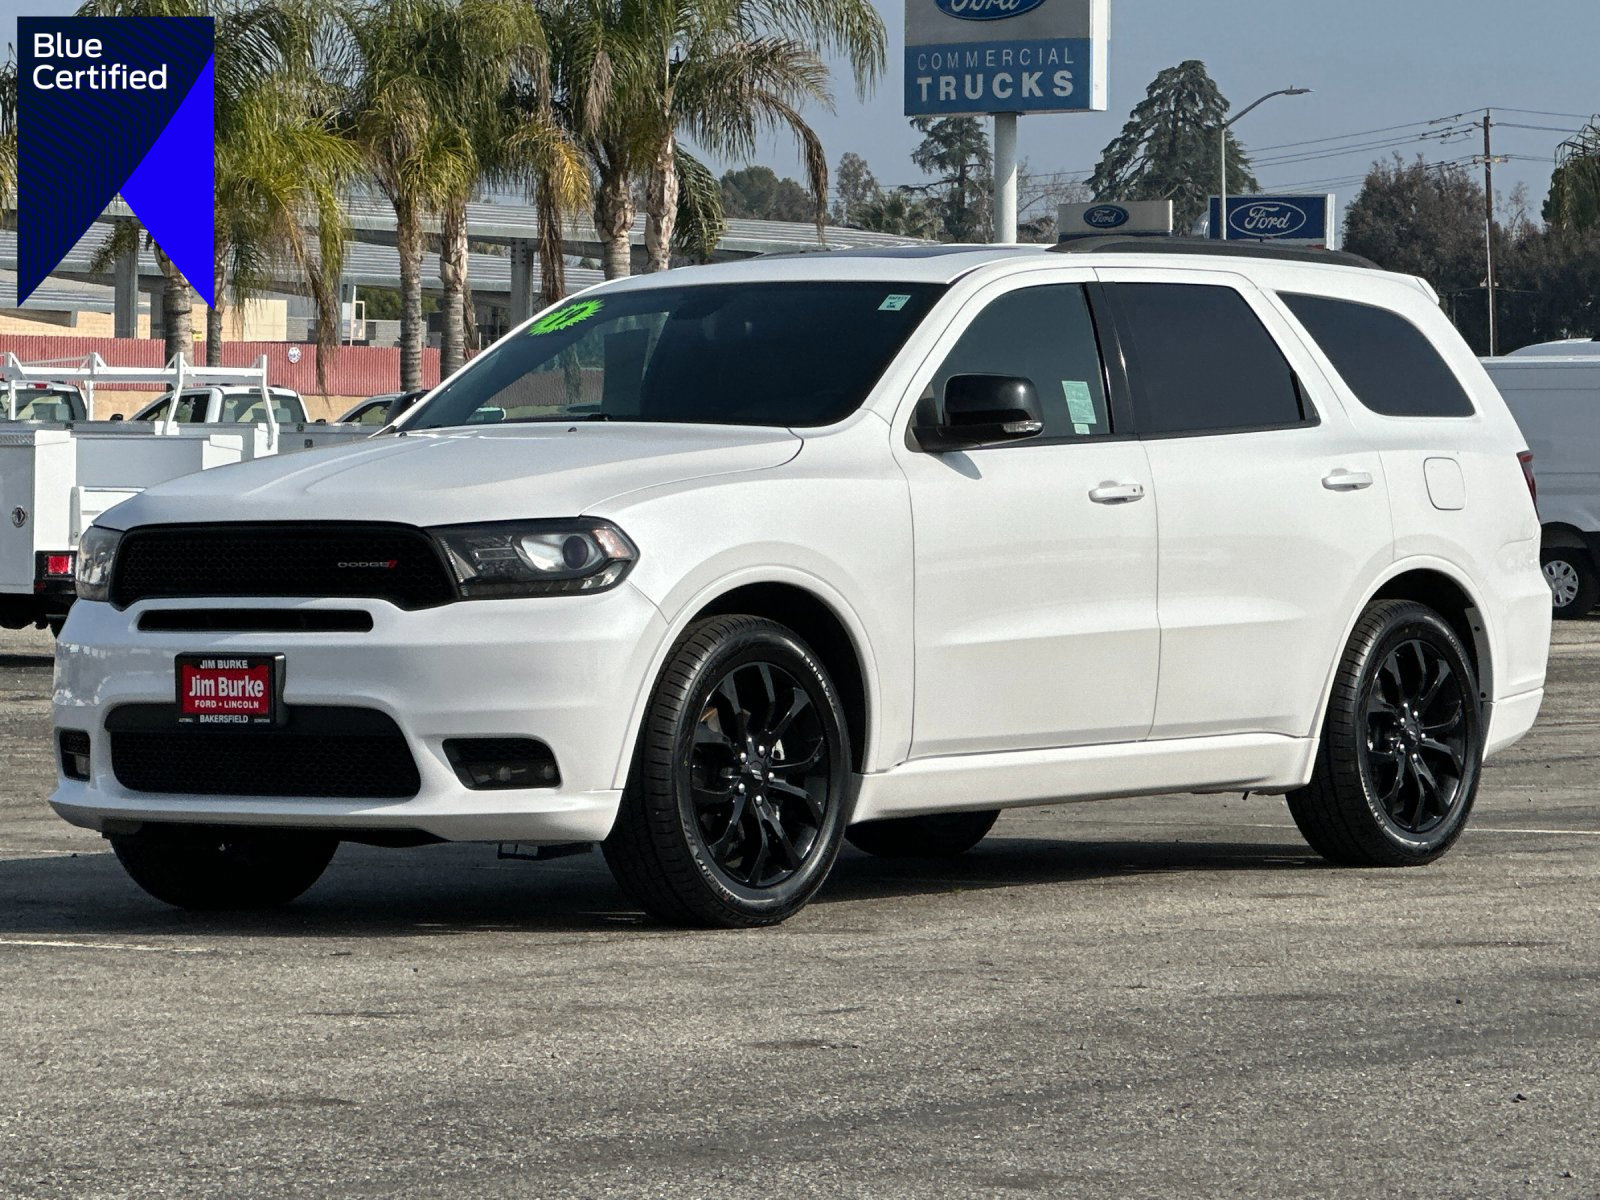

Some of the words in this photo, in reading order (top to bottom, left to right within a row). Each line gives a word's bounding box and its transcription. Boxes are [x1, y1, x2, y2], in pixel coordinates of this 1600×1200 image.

[917, 47, 1074, 71] COMMERCIAL
[916, 70, 1074, 102] TRUCKS
[1091, 210, 1117, 223] Ford
[1244, 205, 1292, 229] Ford
[337, 561, 389, 569] DODGE
[200, 660, 216, 669] JIM
[217, 660, 249, 669] BURKE
[189, 675, 215, 697] Jim
[218, 675, 264, 697] Burke
[195, 700, 217, 708] FORD
[224, 700, 259, 709] LINCOLN
[200, 715, 249, 723] BAKERSFIELD
